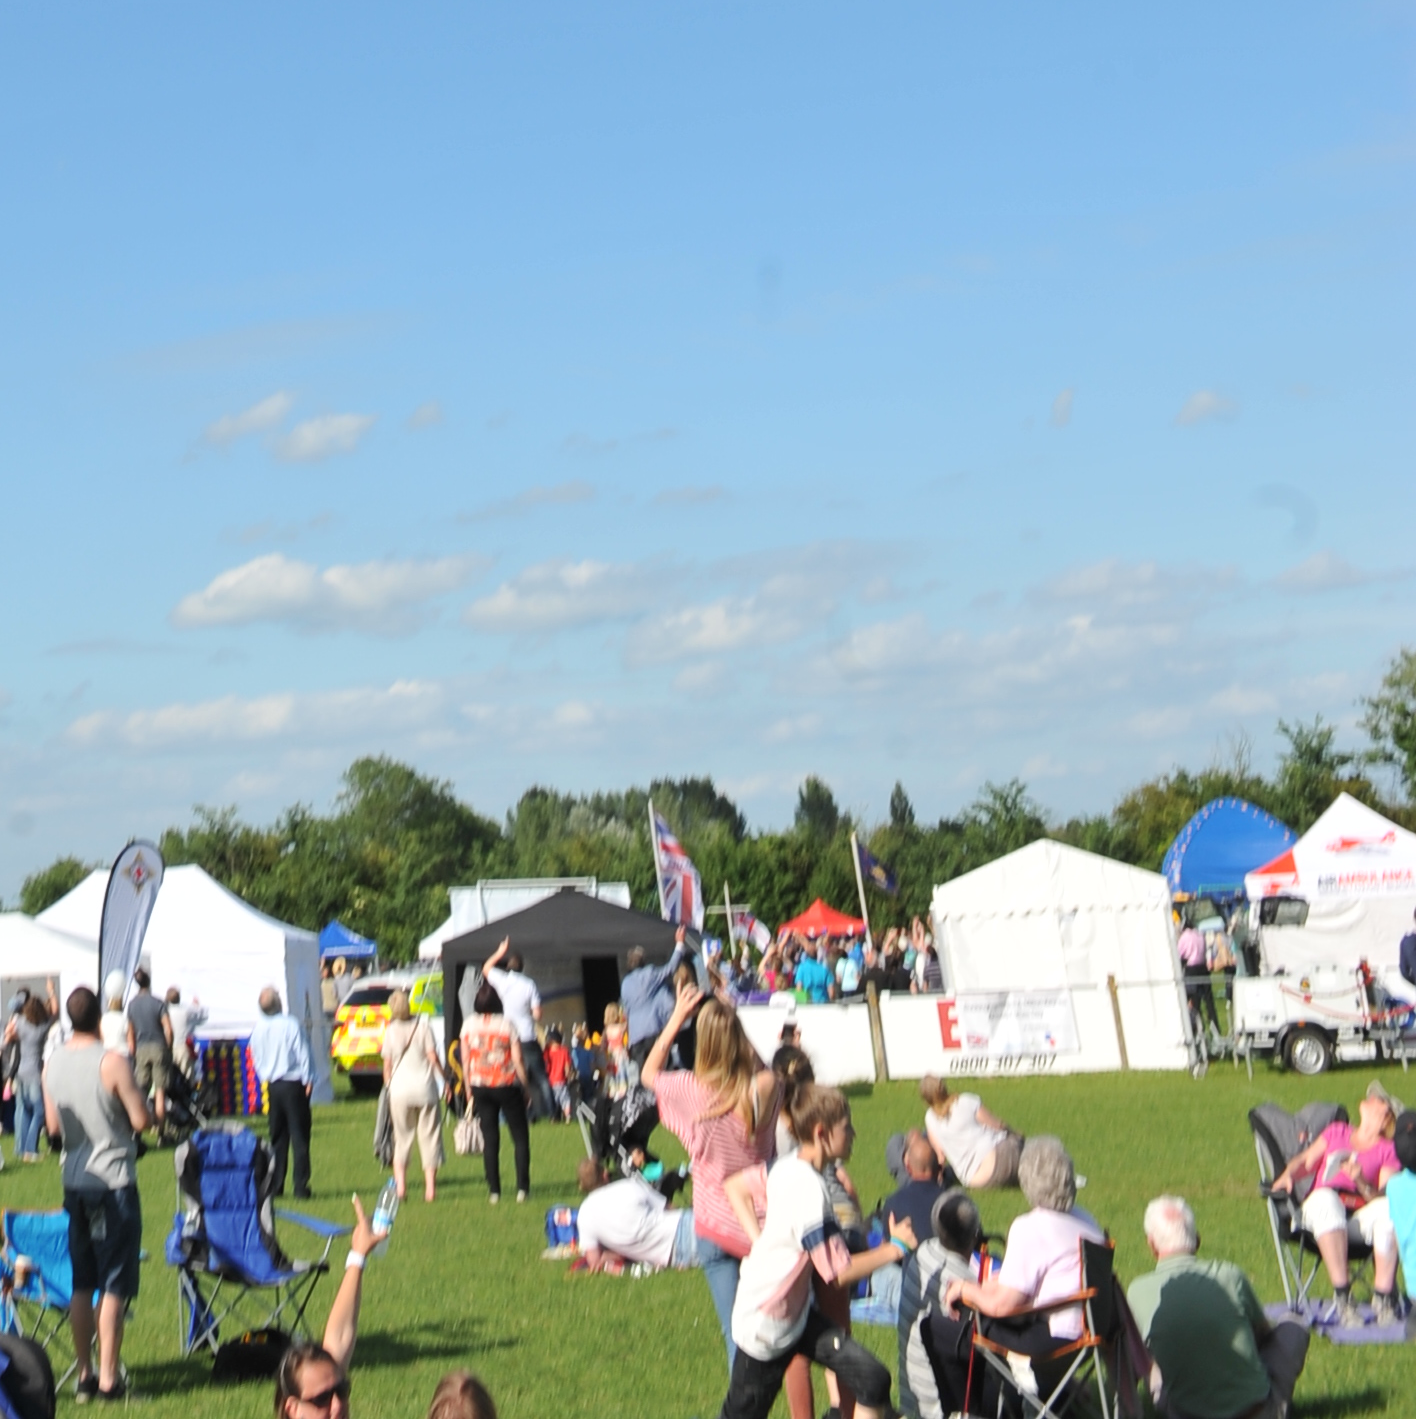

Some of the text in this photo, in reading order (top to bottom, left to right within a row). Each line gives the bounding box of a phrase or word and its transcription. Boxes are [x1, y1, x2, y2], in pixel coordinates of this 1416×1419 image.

[950, 1052, 1058, 1075] 0800 307 307
